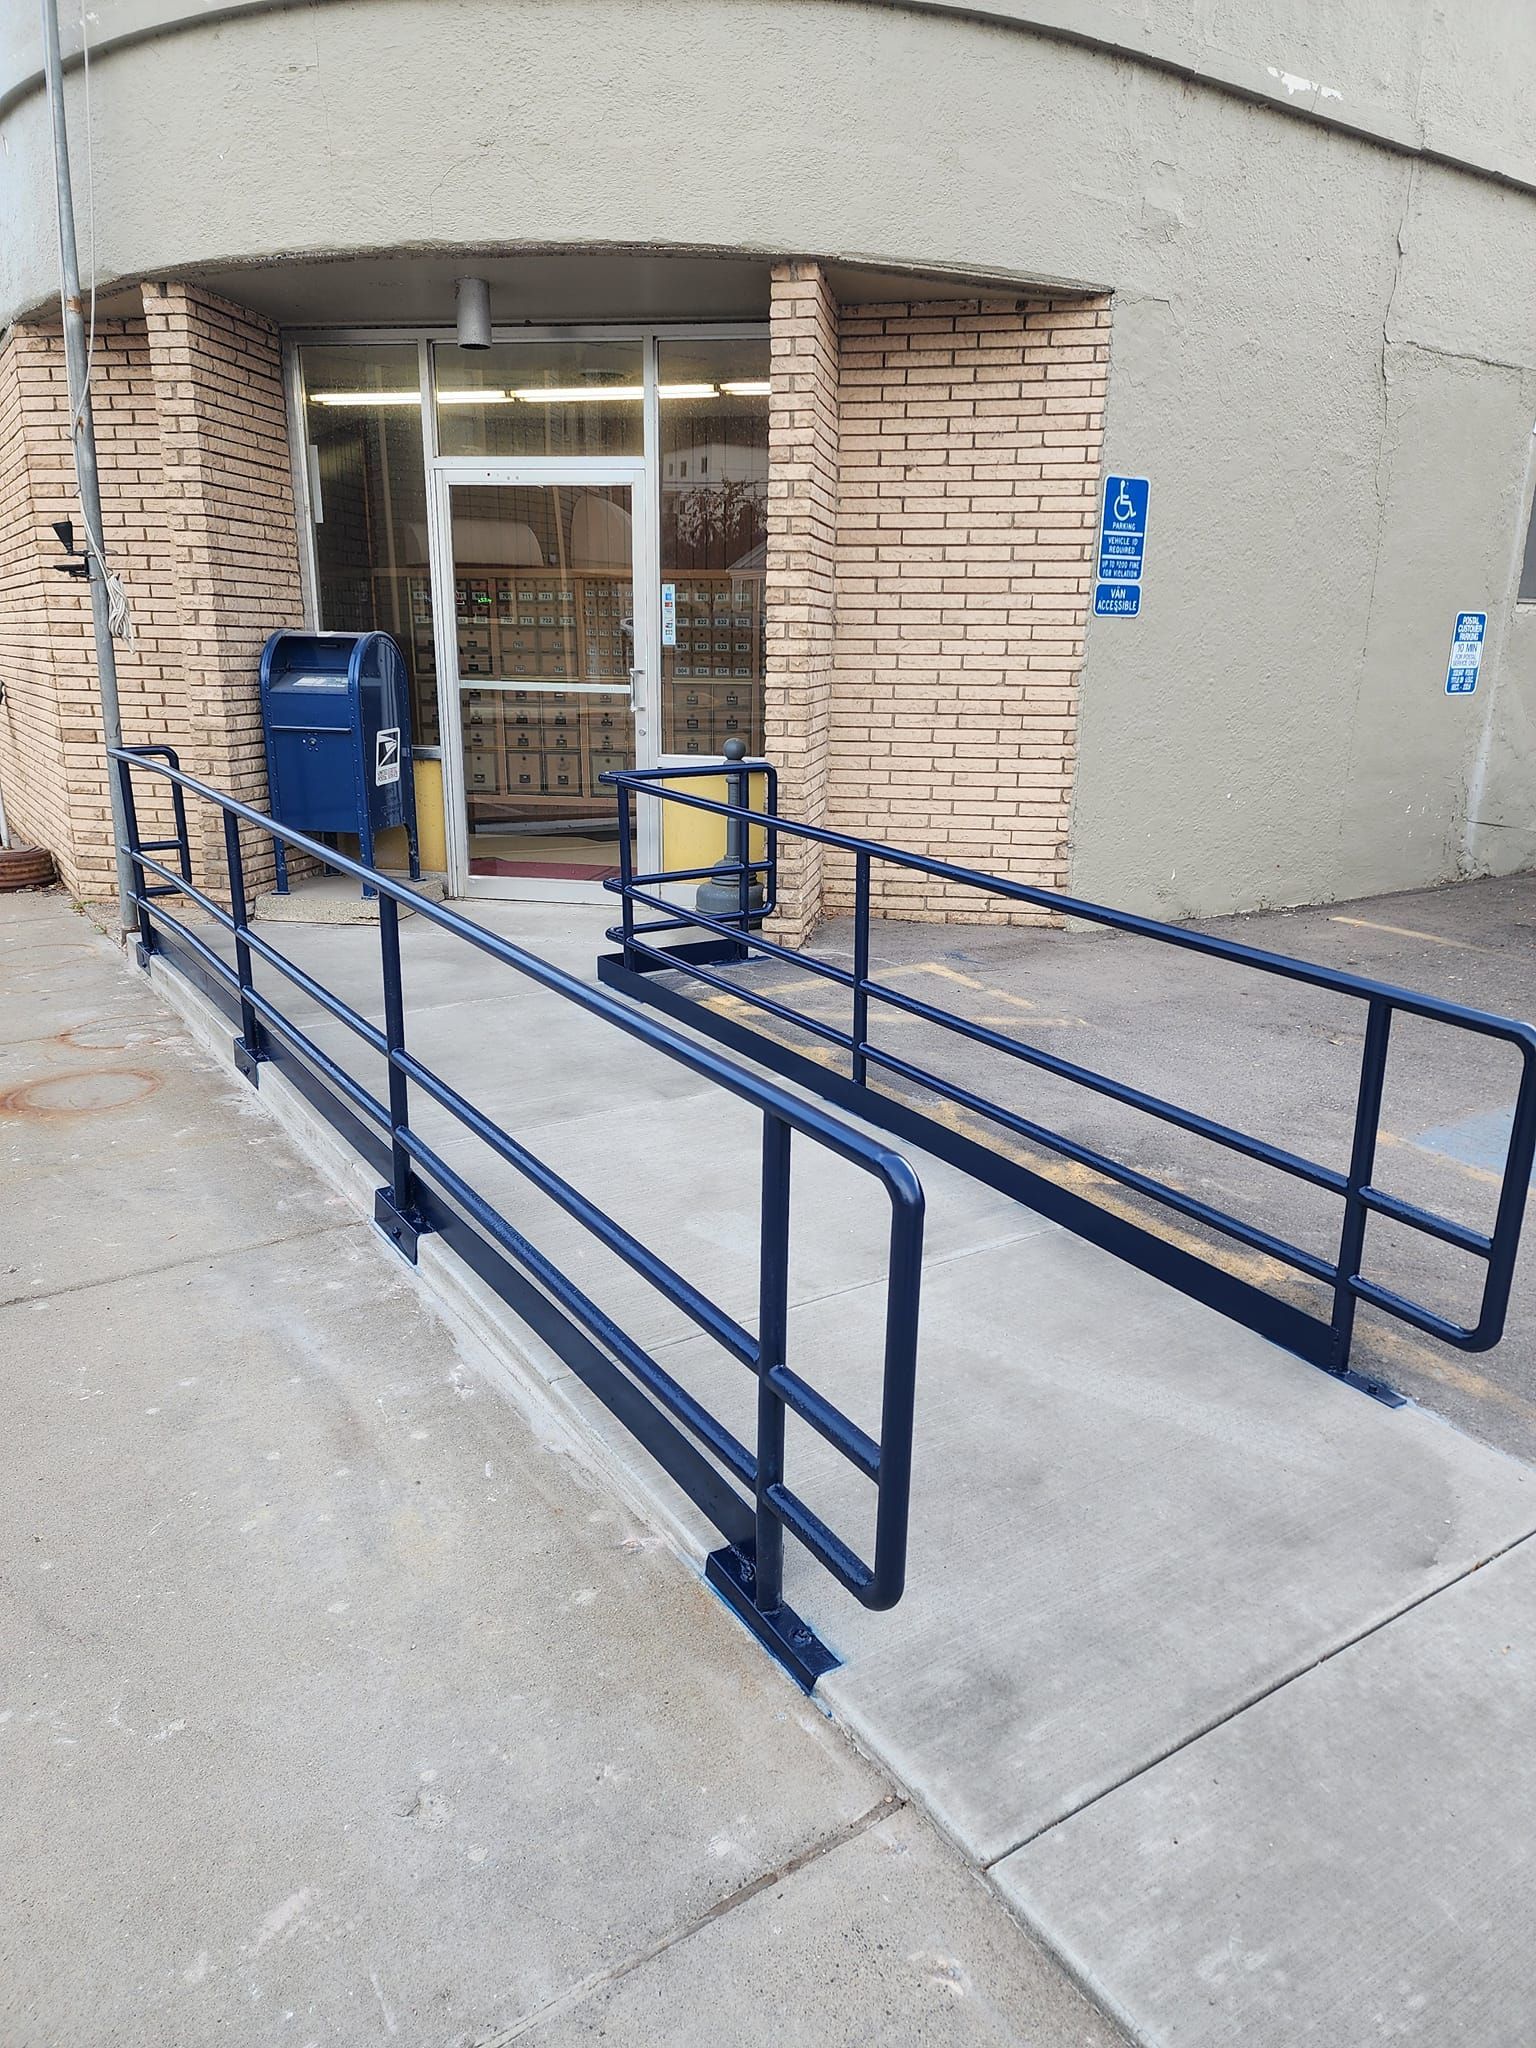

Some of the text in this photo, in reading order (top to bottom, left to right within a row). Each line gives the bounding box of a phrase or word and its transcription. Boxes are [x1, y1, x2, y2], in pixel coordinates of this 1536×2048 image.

[1112, 521, 1136, 531] PARKING
[1108, 536, 1139, 546] VEHICLE ID
[1108, 545, 1136, 555] REQUIRED
[1101, 559, 1109, 567] UP
[1129, 561, 1140, 570] FINE
[1102, 568, 1138, 578] FOR VIOLATION
[1110, 587, 1127, 599] VAN
[1097, 599, 1137, 611] ACCESSIBLE
[1462, 615, 1480, 625] POSTAL
[1457, 624, 1483, 633] CUSTOMER
[1458, 632, 1479, 641] PARKING
[1465, 643, 1478, 653] MIN
